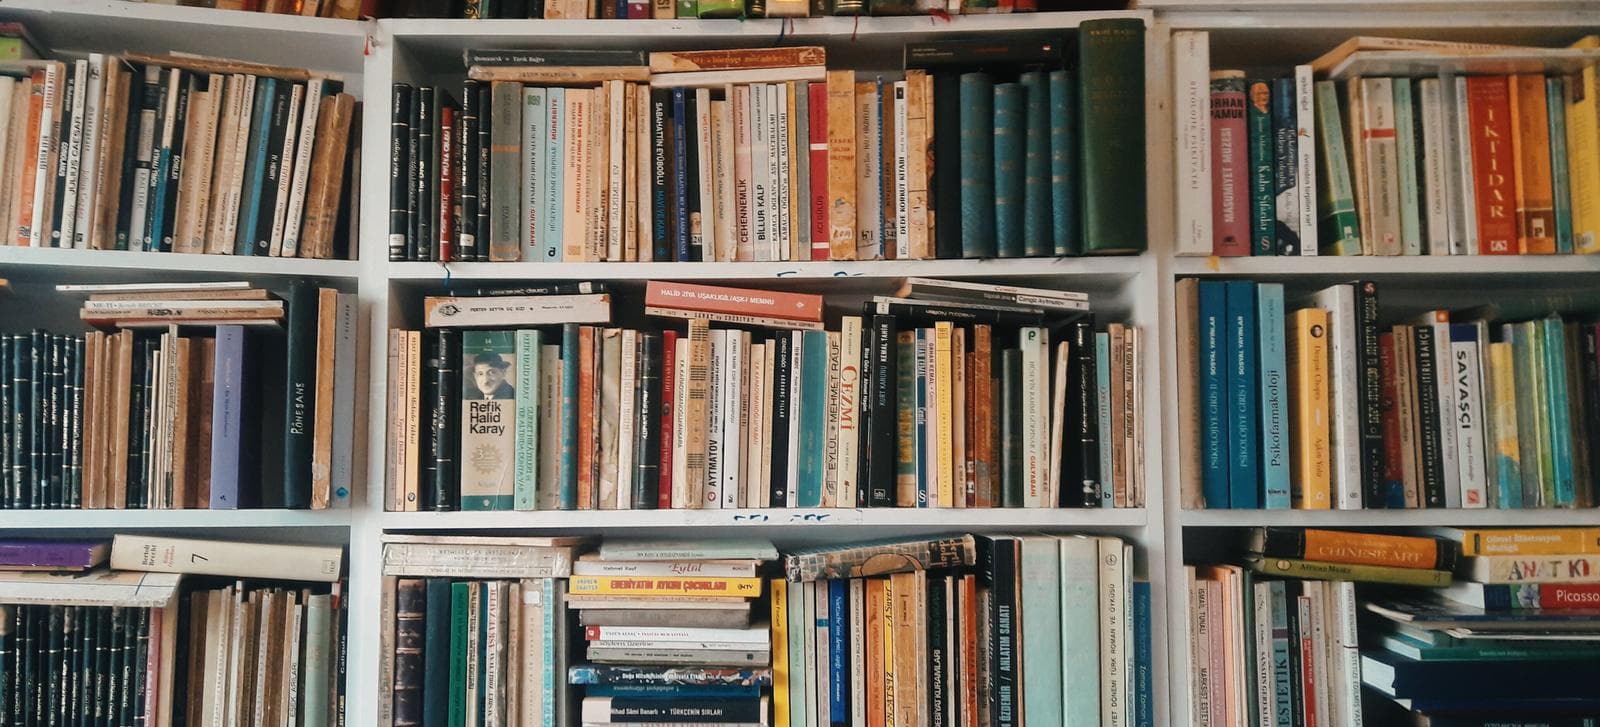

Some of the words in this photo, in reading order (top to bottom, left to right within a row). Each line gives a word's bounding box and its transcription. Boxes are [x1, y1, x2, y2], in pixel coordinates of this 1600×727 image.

[72, 116, 82, 158] CAESAR
[655, 102, 664, 147] SABAHATTİN
[69, 160, 79, 194] JULIUS
[656, 148, 665, 186] EYÜBOĞLU
[898, 156, 906, 182] KİTABI
[1258, 164, 1270, 192] Kadın
[739, 178, 748, 243] CEHENNEMLİK
[756, 184, 765, 208] KALP
[898, 184, 906, 213] KORKUT
[1222, 168, 1234, 223] MASUMİYET
[756, 210, 766, 240] BİLLUR
[880, 324, 888, 342] TAHİR
[1208, 316, 1216, 349] YAYINLAR
[1237, 316, 1245, 348] YAYINLAR
[830, 340, 840, 372] RAUF
[880, 342, 888, 362] KEMAL
[1208, 350, 1216, 376] SOSYAL
[830, 374, 838, 423] MEHMET
[840, 366, 858, 431] CEZMİ
[1456, 350, 1471, 430] SAVAŞÇI
[470, 401, 502, 412] Refik
[470, 412, 502, 424] Halid
[1267, 370, 1281, 467] Psikofarmakoloji
[470, 424, 506, 437] Karay
[708, 440, 718, 488] AYTMATOV
[828, 434, 837, 470] EYLÜL
[191, 552, 208, 564] 7
[1319, 546, 1386, 559] CHINESE
[1390, 550, 1424, 562] ART
[1108, 583, 1116, 612] ÖYKÜSÜ
[1556, 590, 1600, 602] Picasso
[998, 604, 1010, 635] SANATI
[1109, 615, 1116, 625] VE
[1198, 612, 1206, 635] TUNALI
[999, 636, 1010, 672] ANLATIM
[933, 649, 942, 698] KURAMLARI
[999, 686, 1010, 721] ÖZDEMİR
[1110, 680, 1118, 707] DÖNEMİ
[1275, 660, 1290, 726] ESTETİK
